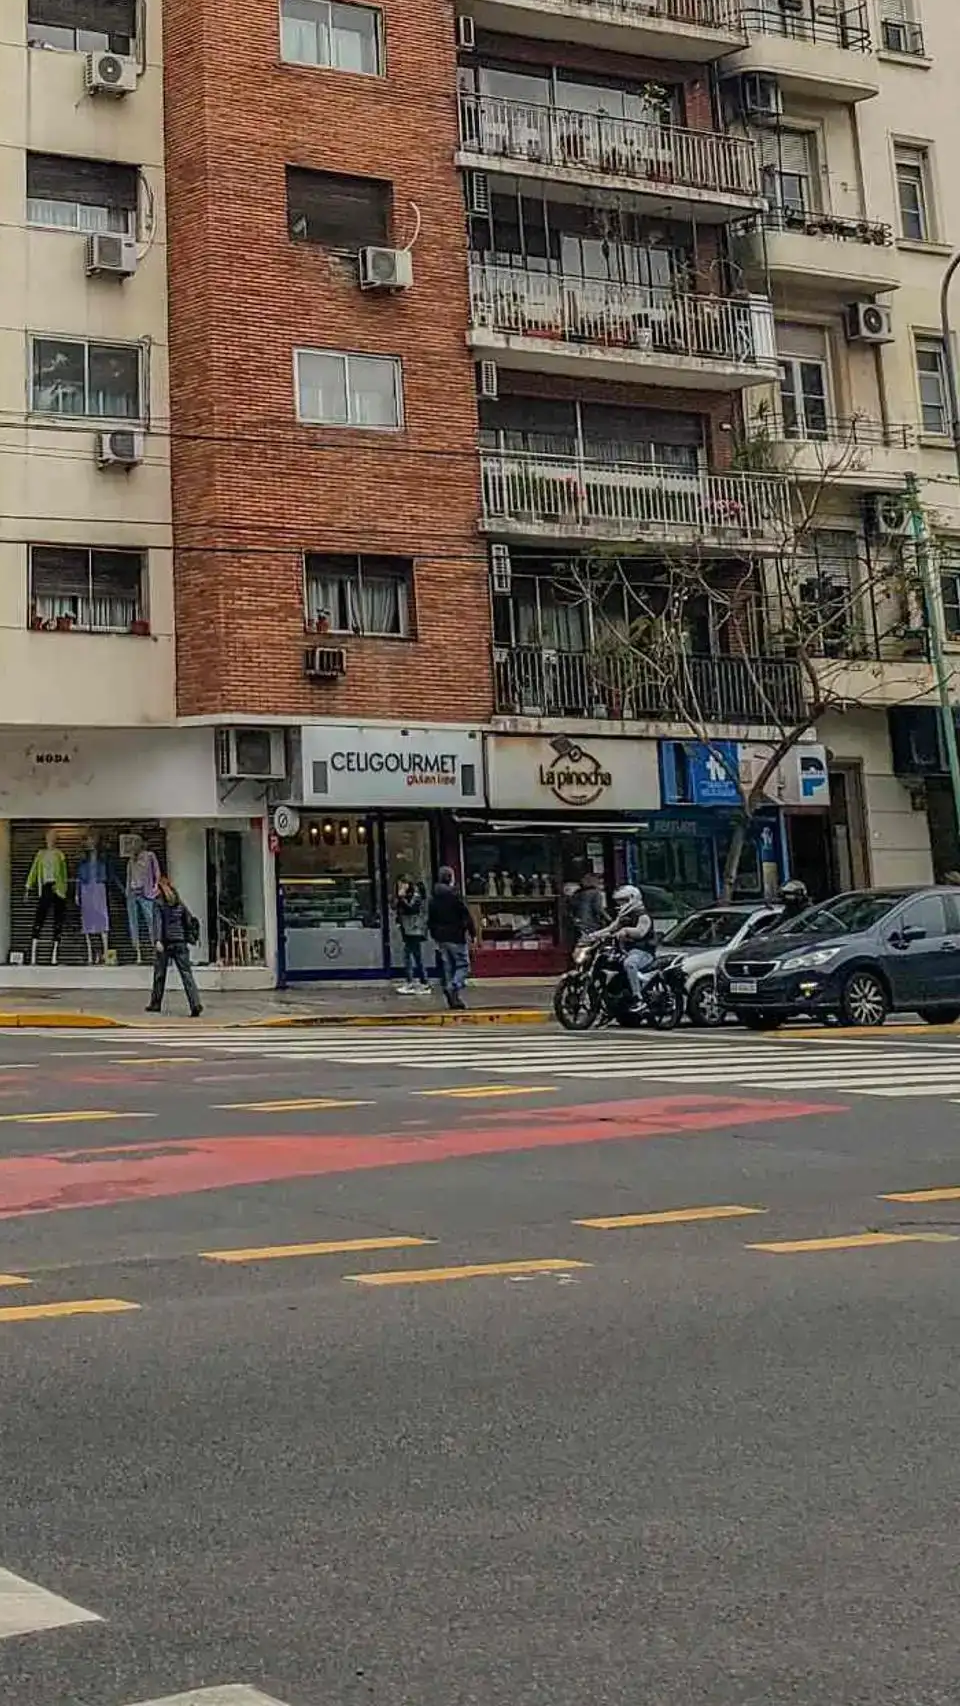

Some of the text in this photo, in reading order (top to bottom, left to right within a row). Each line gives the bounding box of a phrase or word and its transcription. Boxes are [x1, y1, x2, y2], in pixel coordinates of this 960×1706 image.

[36, 754, 70, 764] MODA
[331, 752, 457, 773] CELIGOURMET
[540, 764, 611, 790] La pinocha
